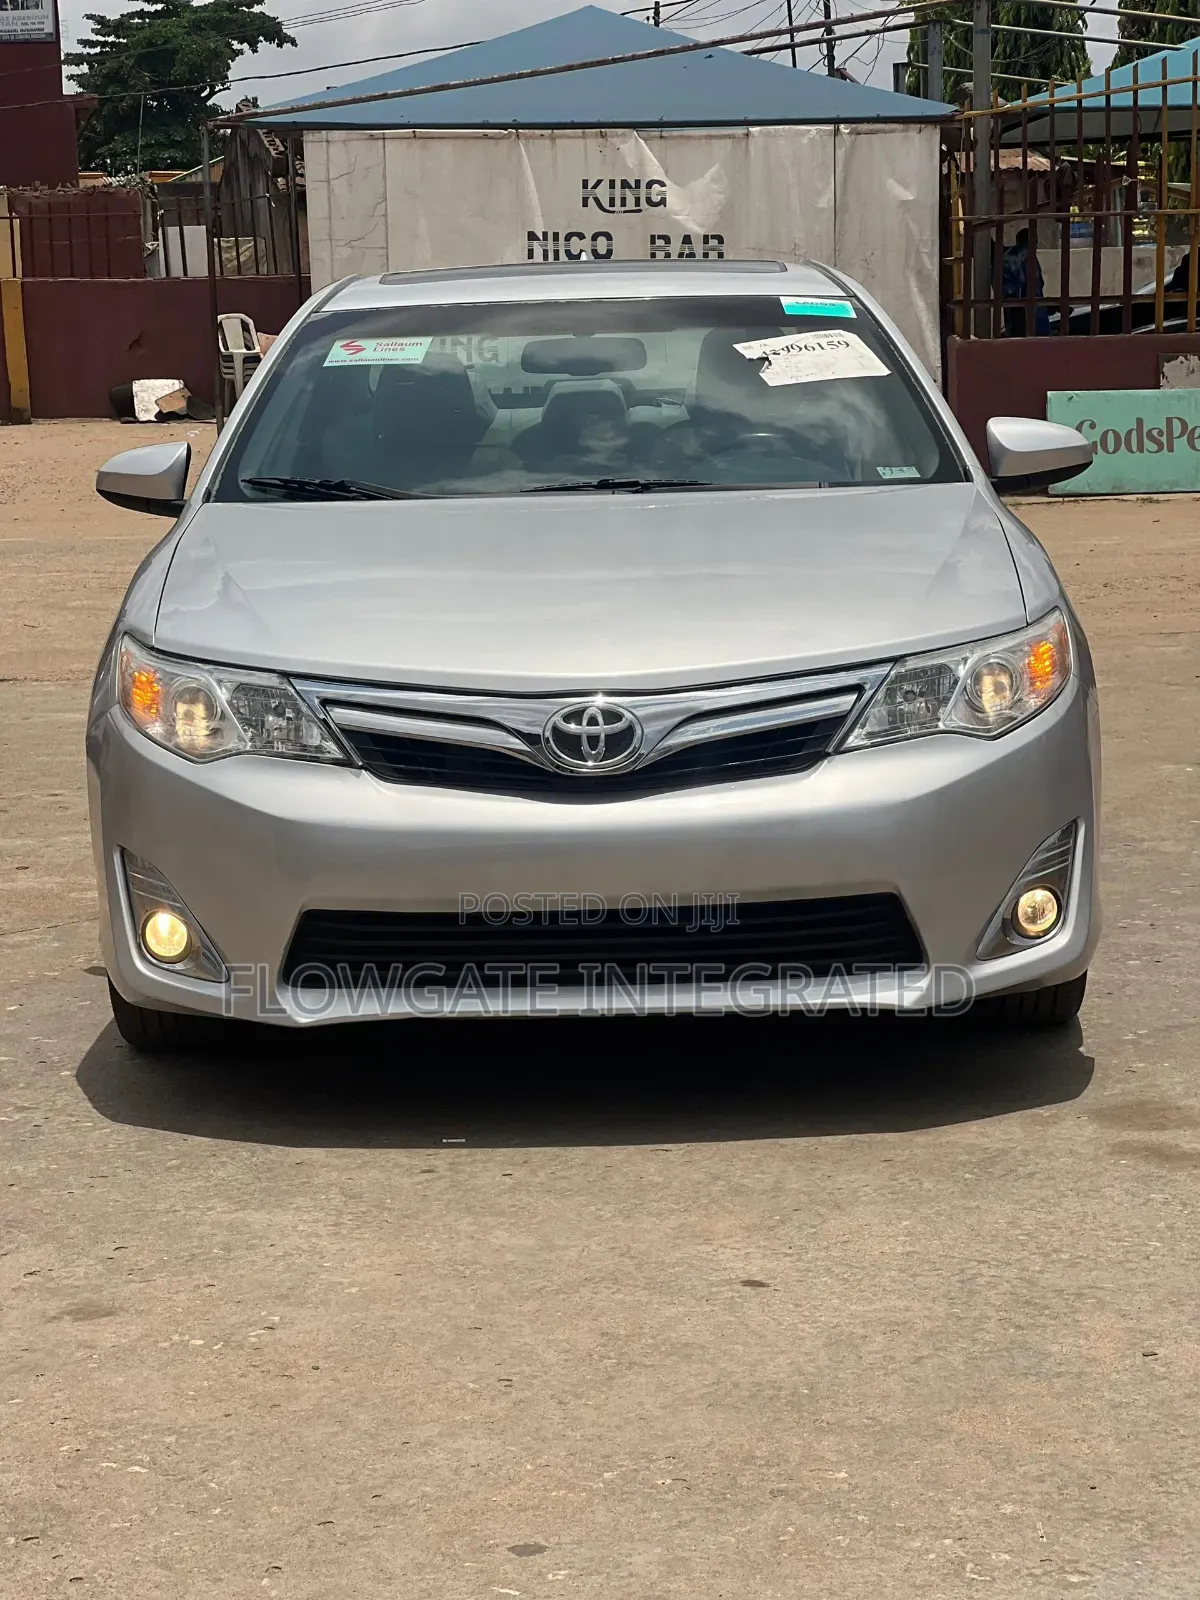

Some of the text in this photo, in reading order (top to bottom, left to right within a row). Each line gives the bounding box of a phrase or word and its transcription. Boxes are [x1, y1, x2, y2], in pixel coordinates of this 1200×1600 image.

[581, 178, 667, 214] KING
[527, 231, 724, 261] NICO BAR
